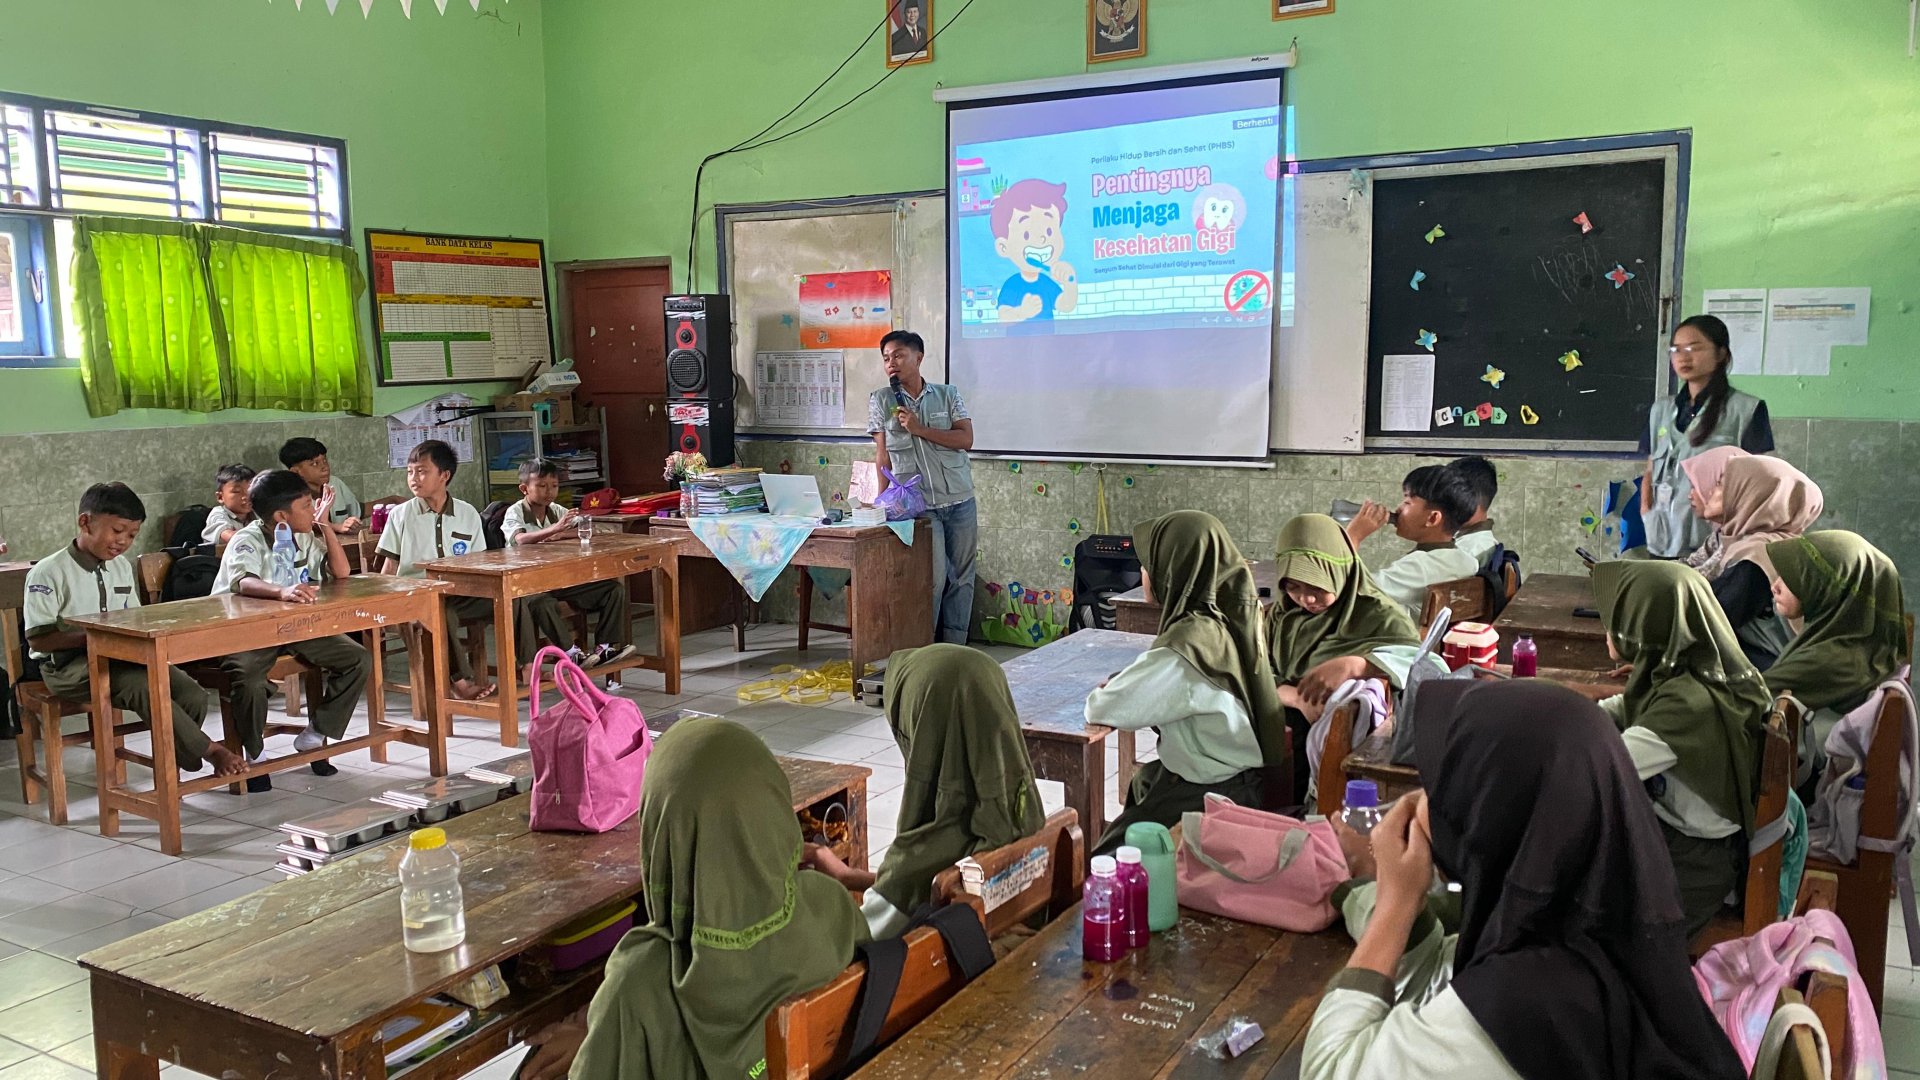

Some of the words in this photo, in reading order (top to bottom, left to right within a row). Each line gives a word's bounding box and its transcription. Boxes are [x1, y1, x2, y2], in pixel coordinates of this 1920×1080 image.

[1236, 117, 1273, 129] Berhenti
[1091, 154, 1119, 164] Perilaku
[1120, 151, 1143, 161] Hidup
[1143, 149, 1167, 158] Bersih
[1168, 147, 1183, 155] dan
[1184, 144, 1206, 153] Sehat
[1208, 141, 1235, 152] (PHBS)
[1091, 165, 1212, 198] Pentingnya
[1092, 200, 1180, 229] Menjaga
[425, 237, 447, 247] BANK
[449, 238, 467, 248] DATA
[469, 240, 493, 250] KELAS
[1093, 232, 1192, 261] Kesehatan
[1197, 226, 1236, 255] Gigi
[1094, 266, 1118, 274] Senyum
[1137, 262, 1162, 271] Dimulai
[1162, 260, 1176, 268] dari
[1176, 260, 1190, 268] Gigi
[1190, 260, 1207, 268] yang
